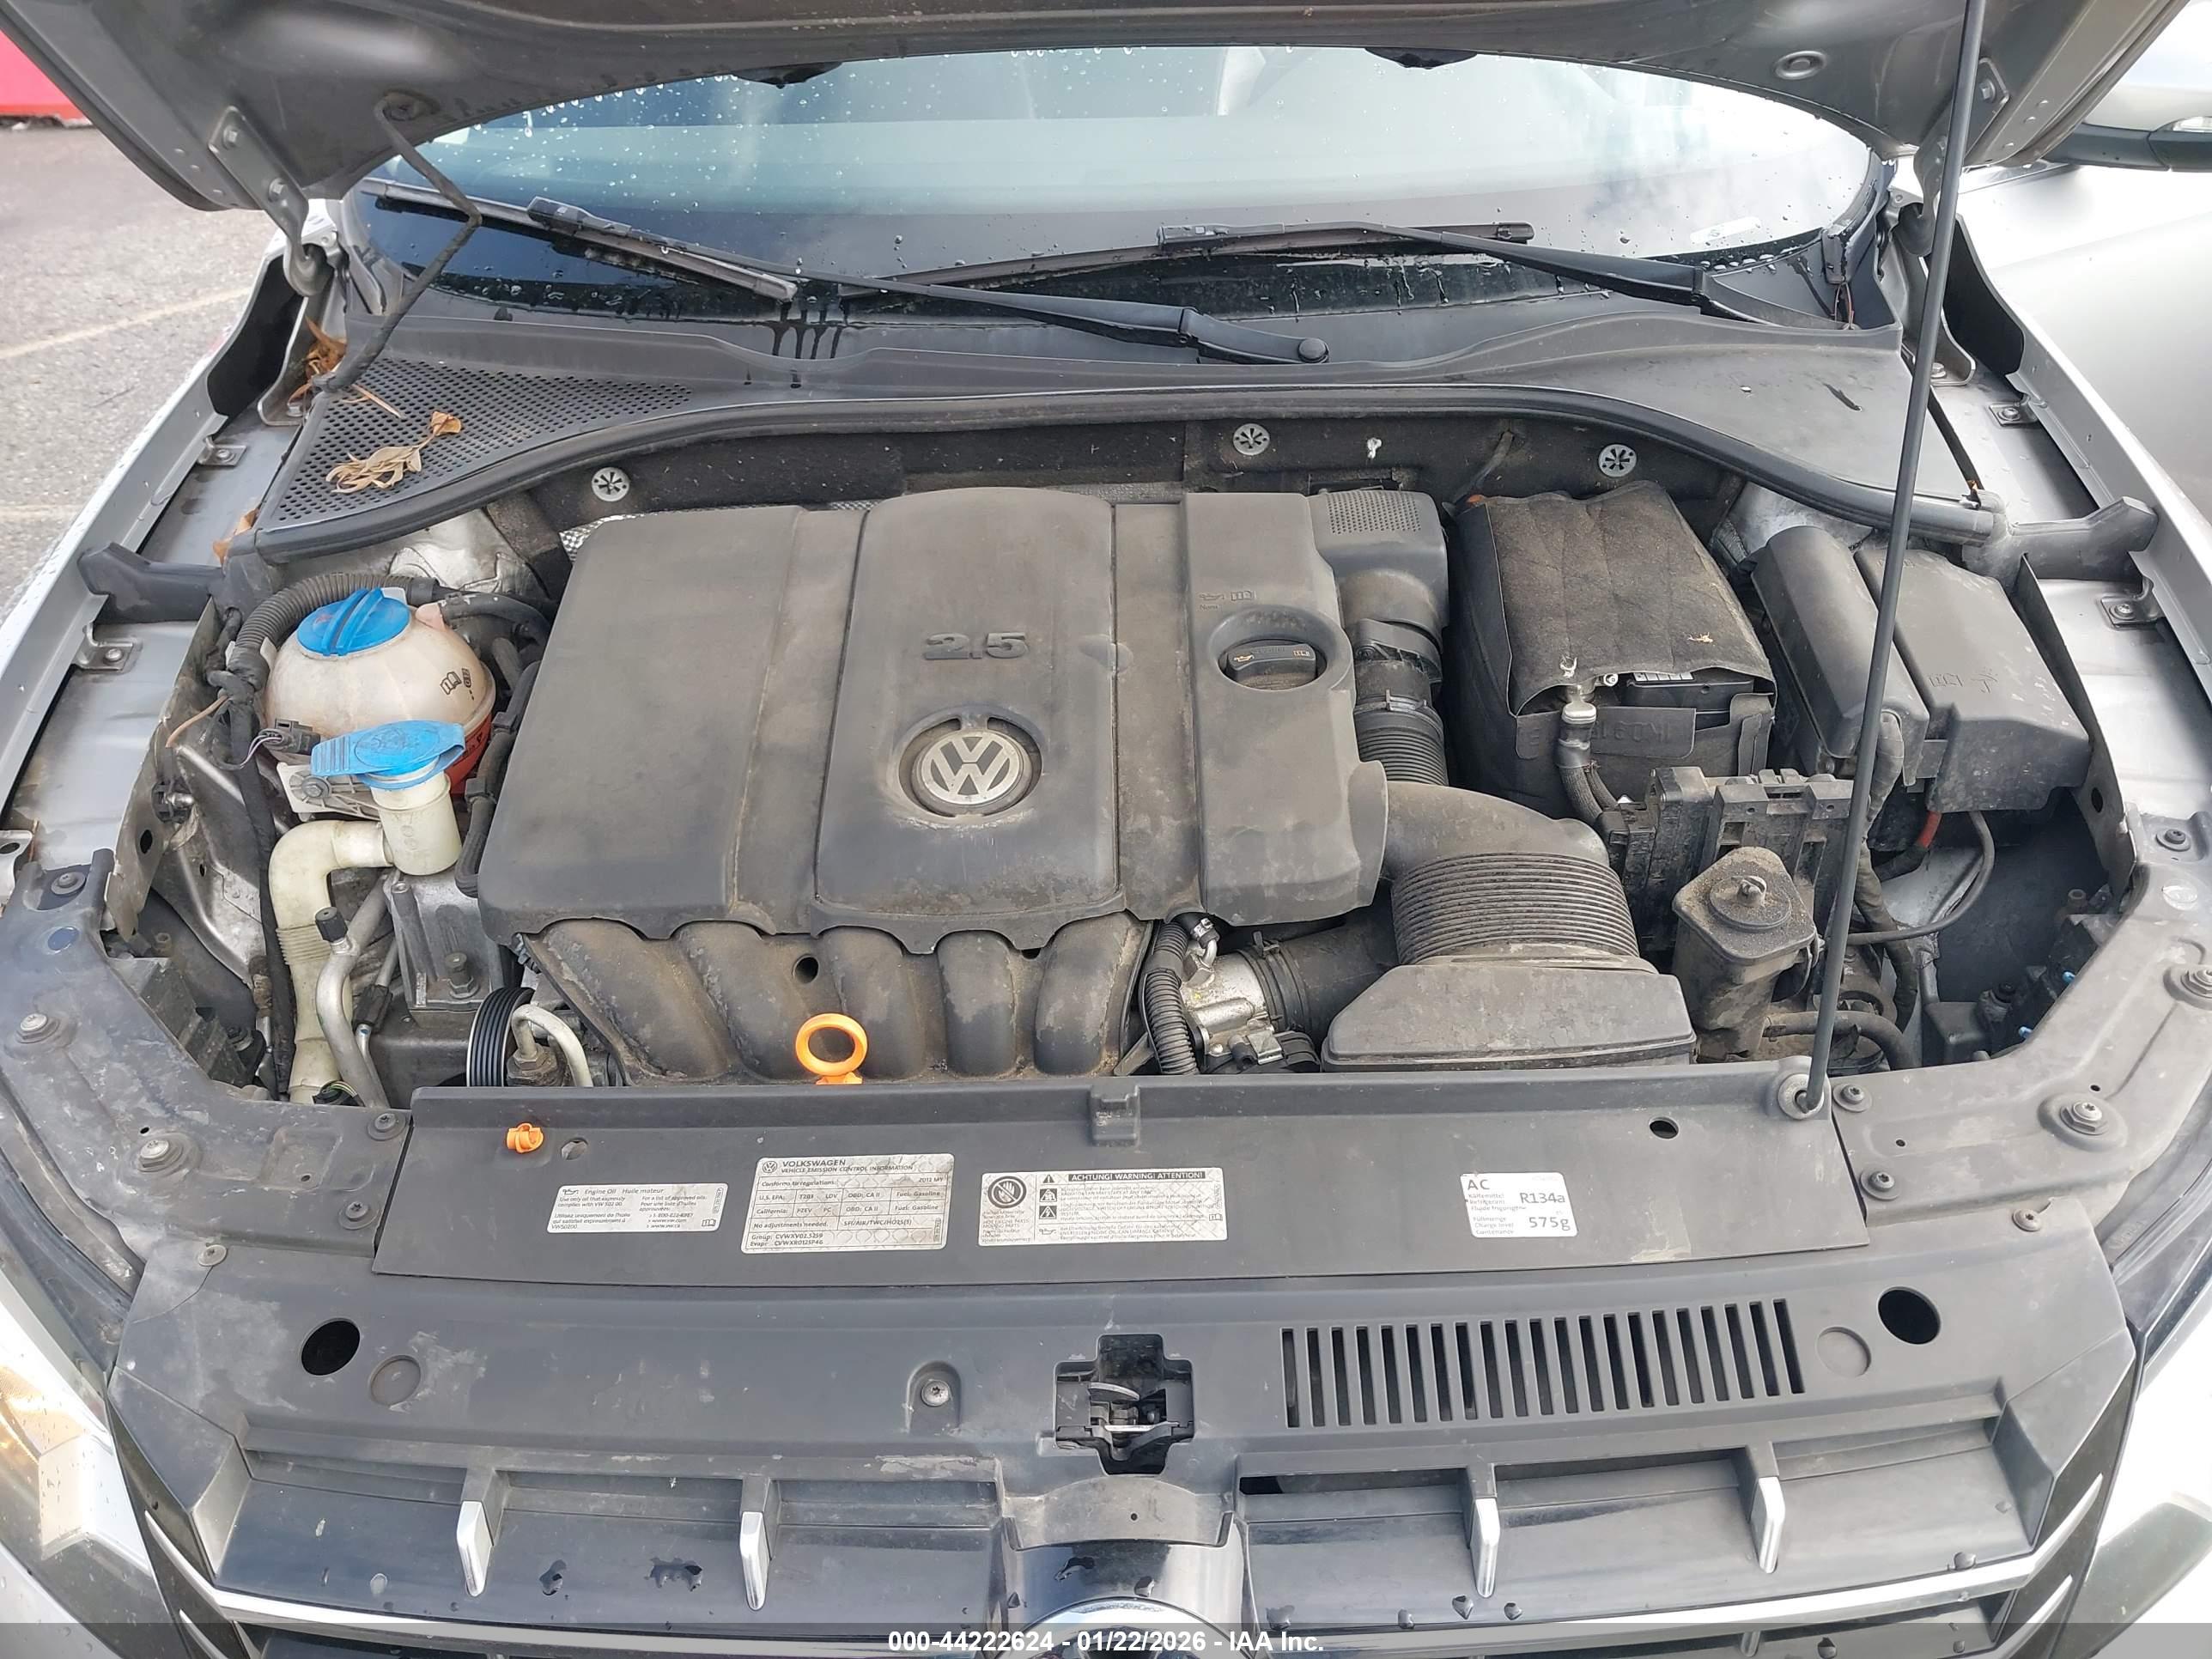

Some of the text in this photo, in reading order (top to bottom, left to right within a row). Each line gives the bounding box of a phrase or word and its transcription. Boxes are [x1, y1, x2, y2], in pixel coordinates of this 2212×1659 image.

[924, 633, 1028, 660] 2.5
[1468, 1179, 1490, 1190] AC
[1520, 1193, 1565, 1203] R134a
[1528, 1217, 1571, 1231] 575g
